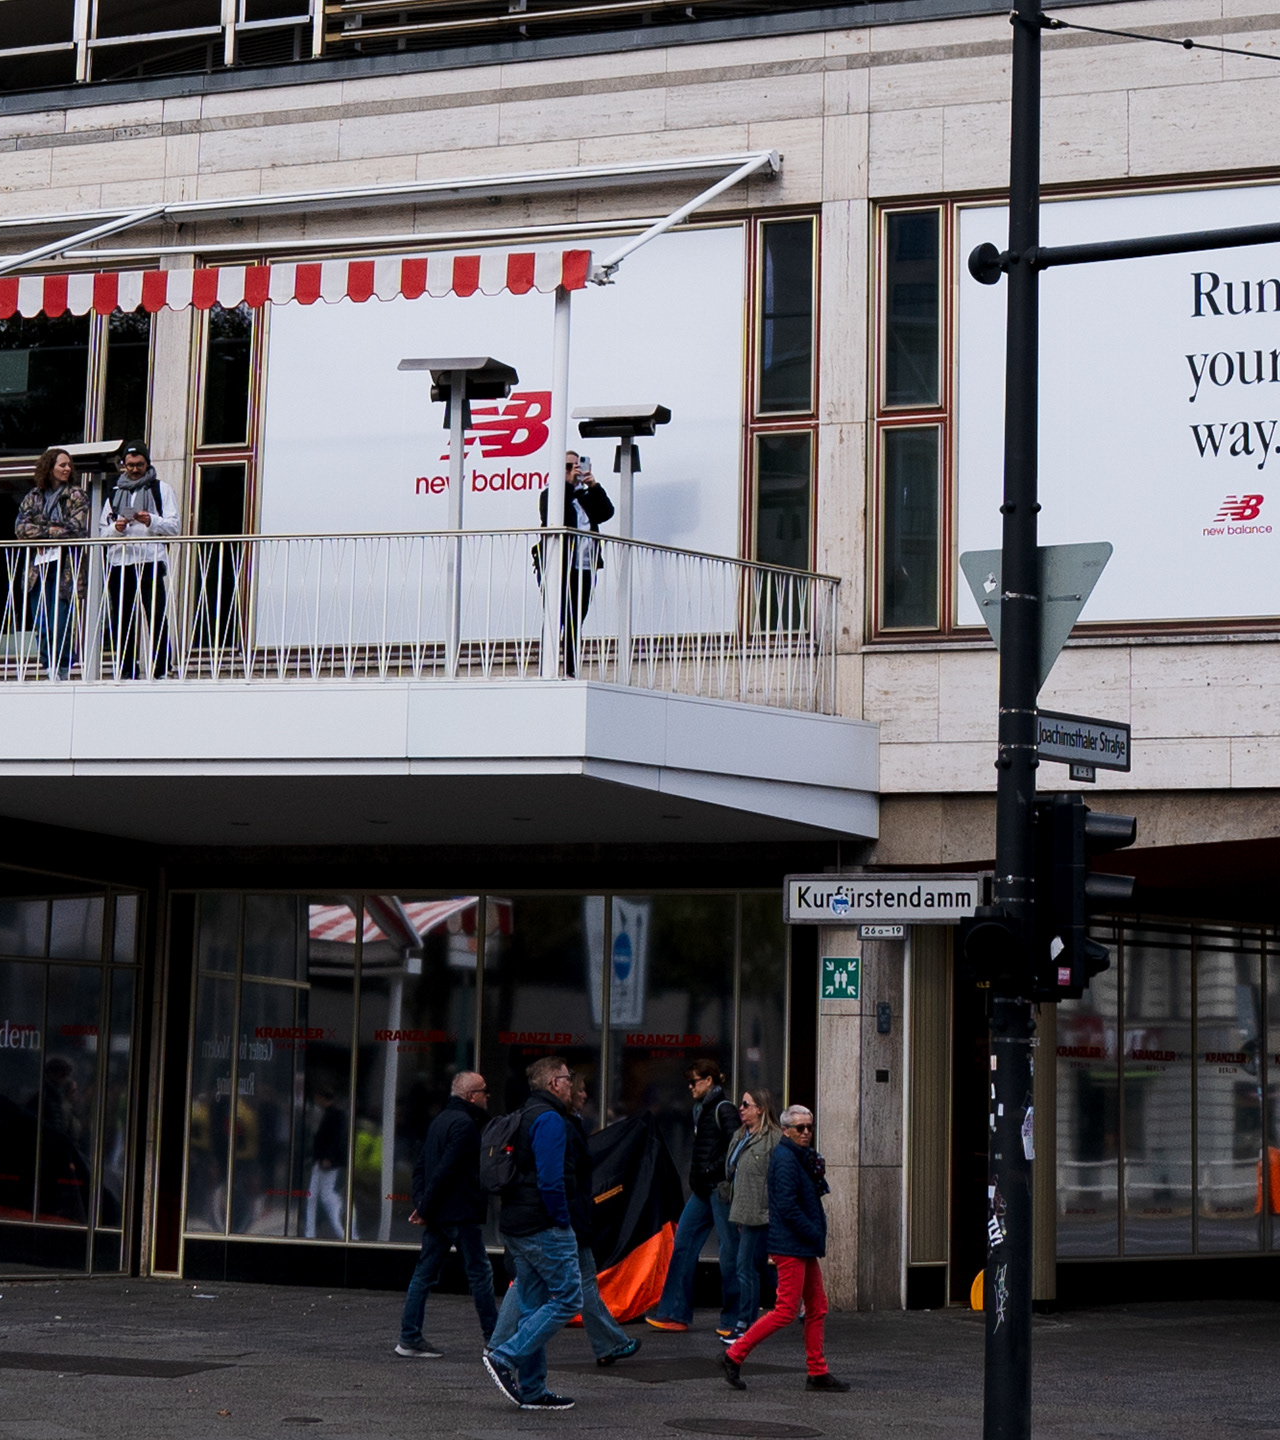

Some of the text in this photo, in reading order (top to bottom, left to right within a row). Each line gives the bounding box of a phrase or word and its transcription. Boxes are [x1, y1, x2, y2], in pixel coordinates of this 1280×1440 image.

[1202, 524, 1273, 536] new balance
[1037, 721, 1125, 759] Joachimsthaler Straße
[255, 1027, 324, 1039] KRANZLER
[374, 1029, 446, 1042] KRANZLER
[498, 1030, 572, 1044] KRANZLER
[626, 1033, 702, 1047] KRANZLER
[1056, 1046, 1101, 1058] KRANZLER
[1132, 1050, 1176, 1061] KRANZLER
[1205, 1052, 1247, 1063] KRANZLER
